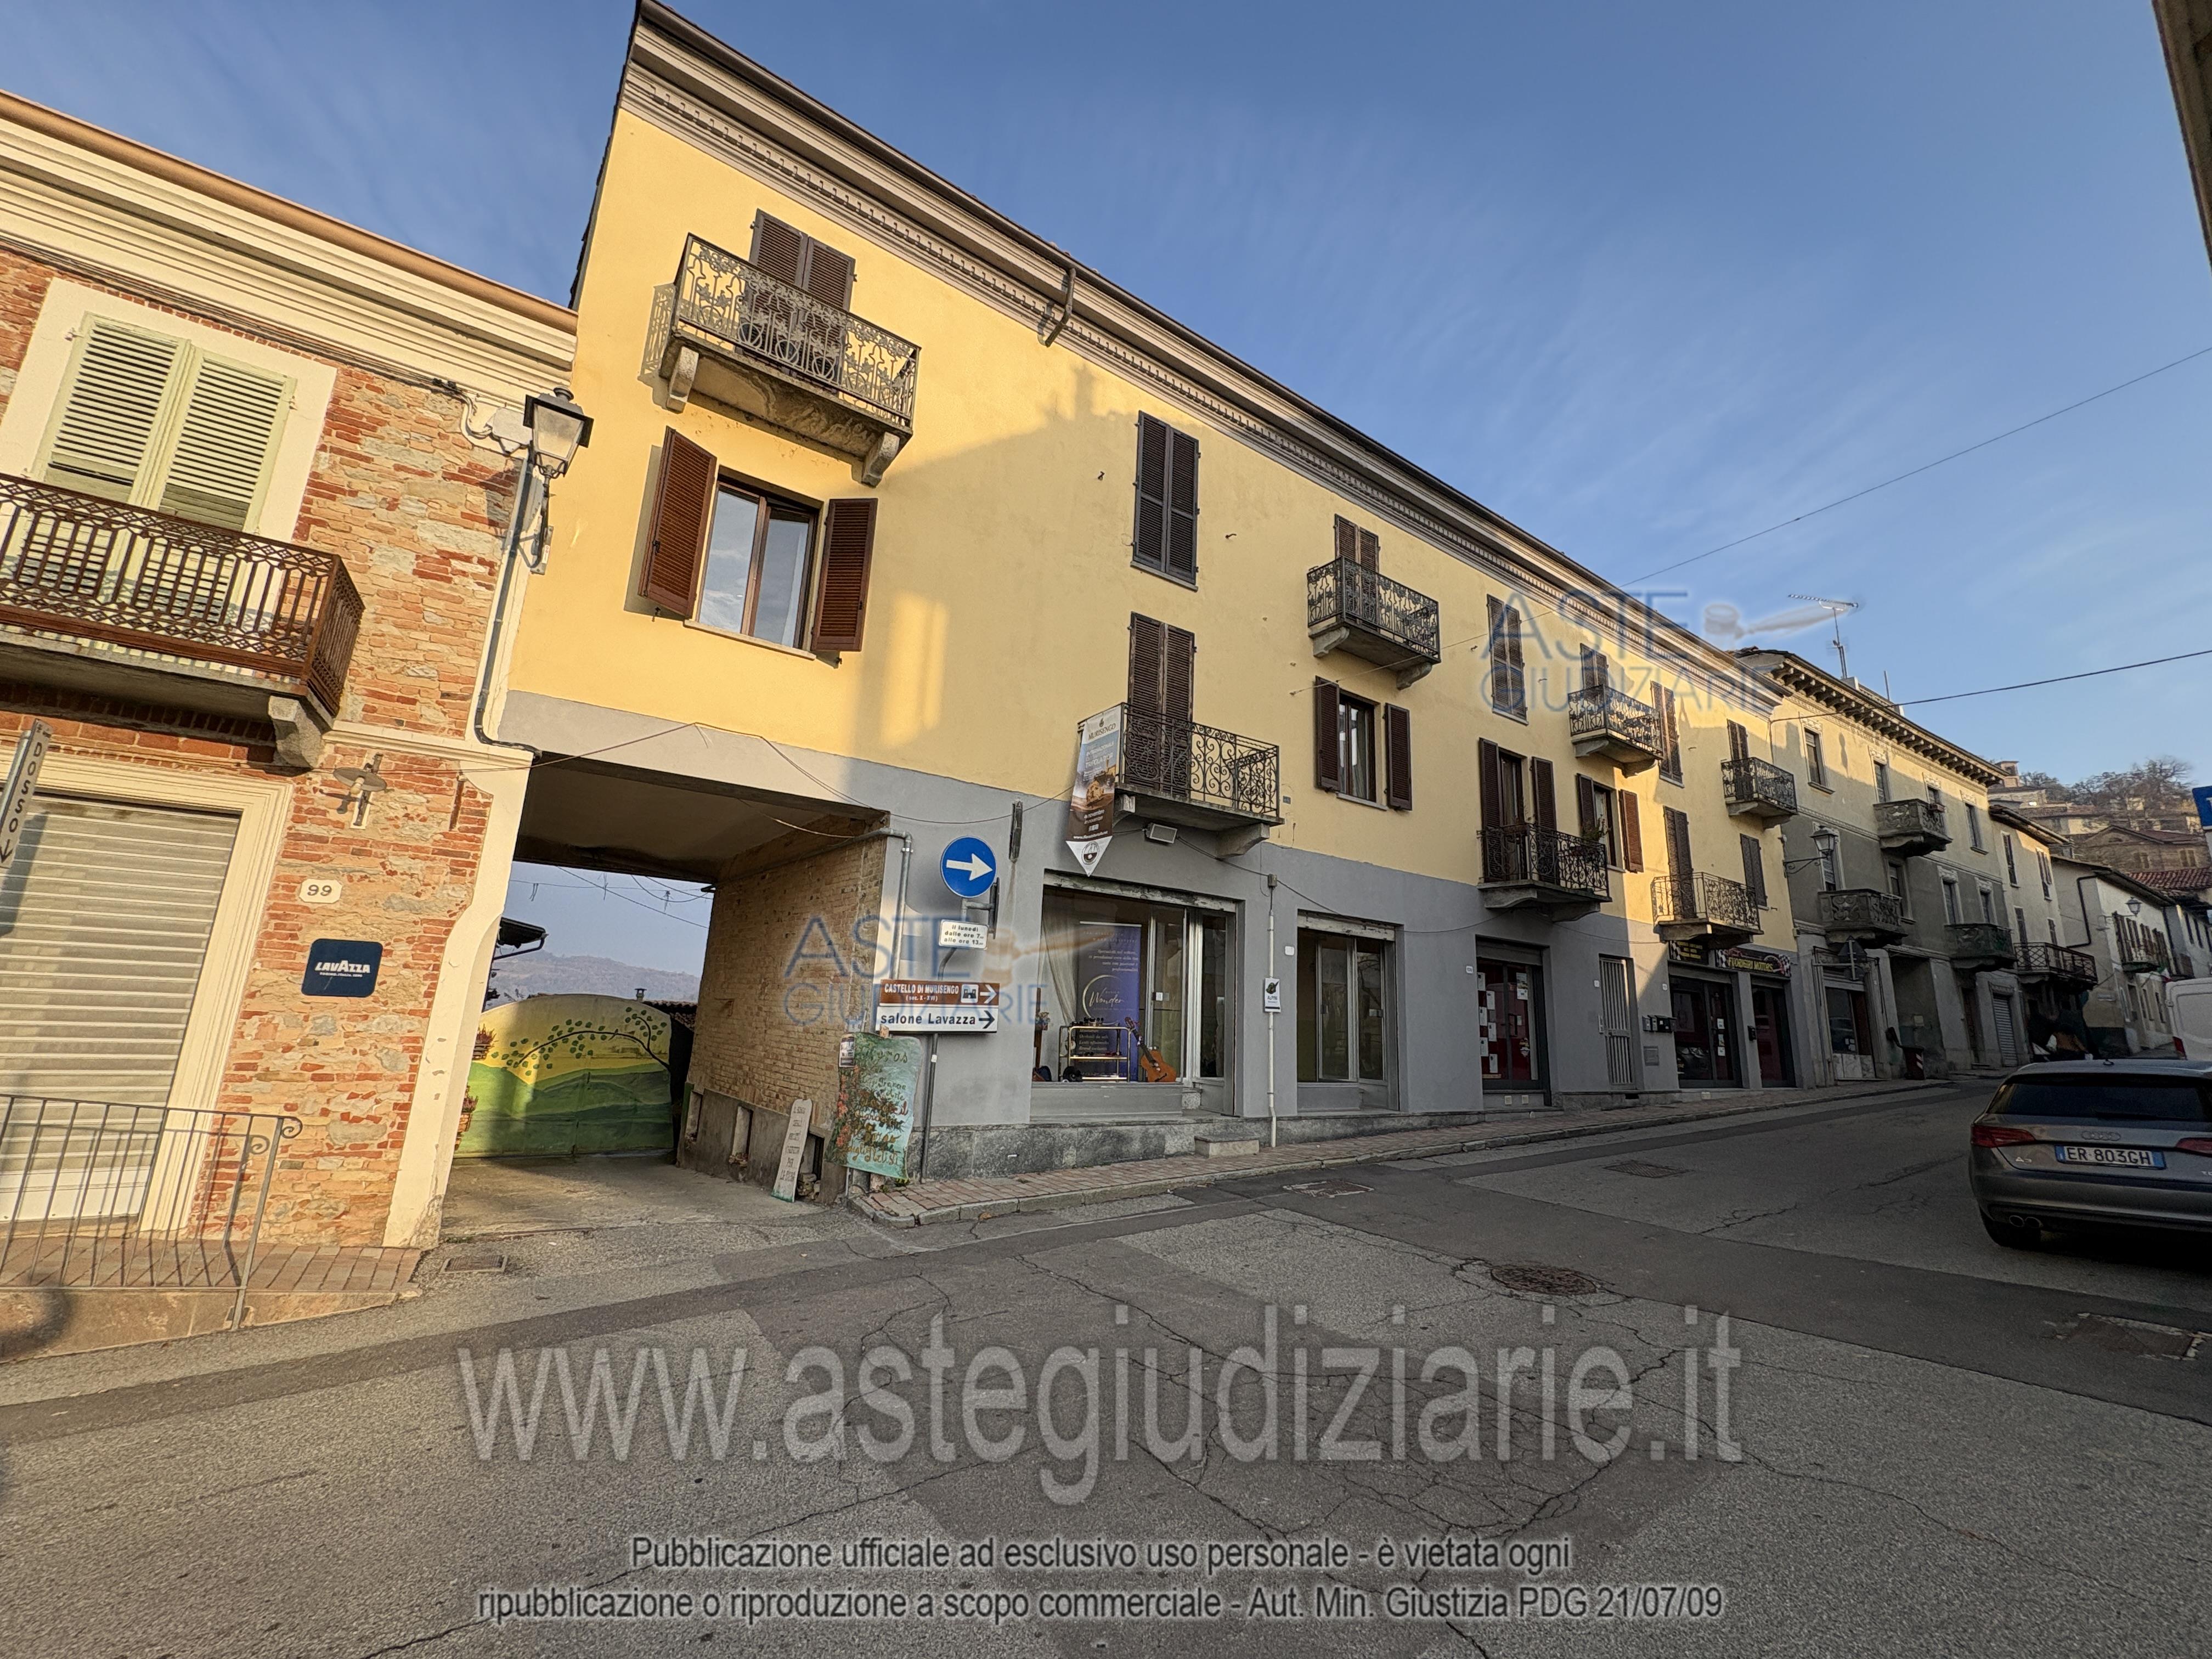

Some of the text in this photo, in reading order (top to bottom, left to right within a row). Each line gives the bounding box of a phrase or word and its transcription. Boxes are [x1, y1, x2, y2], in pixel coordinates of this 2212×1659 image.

[9, 742, 42, 833] DOSSO
[307, 884, 332, 896] 99
[314, 960, 371, 973] LAVAZZA
[884, 983, 959, 994] CASTELLO DI MURISENGO
[881, 1013, 976, 1024] salone Lavazza
[2067, 1147, 2087, 1161] ER
[2094, 1149, 2152, 1165] 803GH
